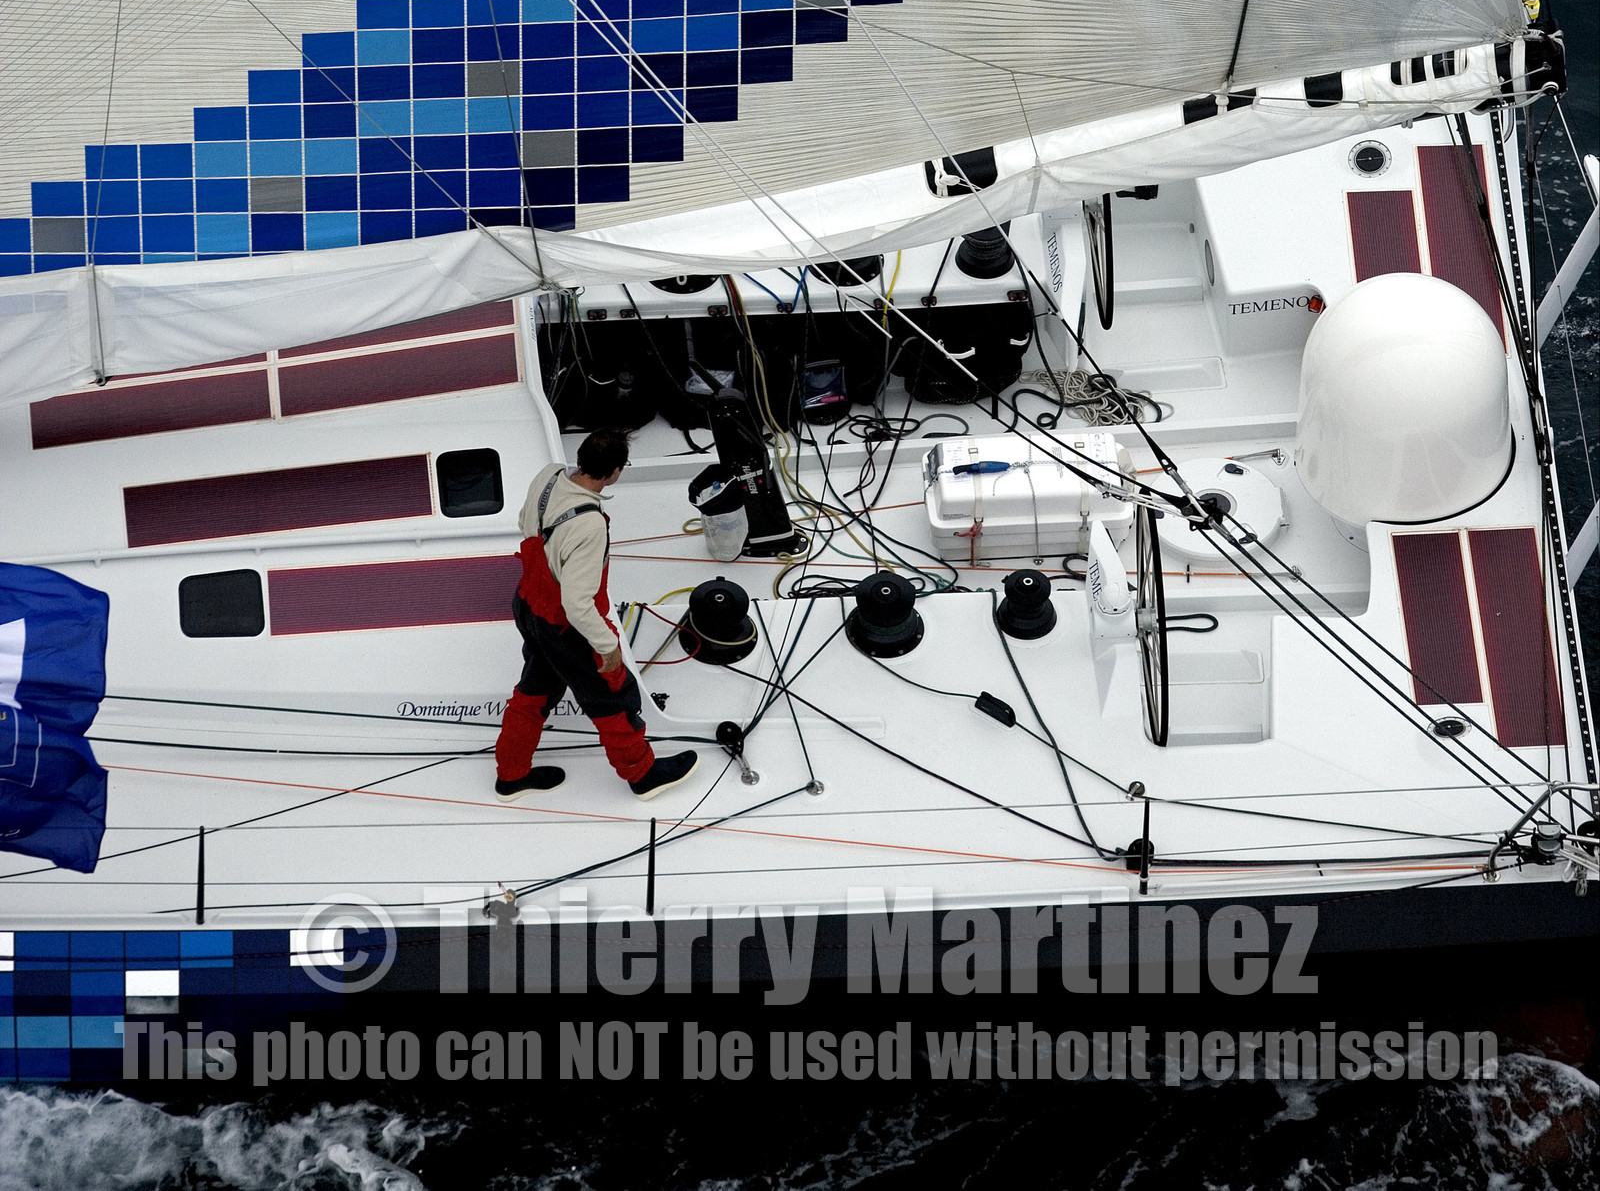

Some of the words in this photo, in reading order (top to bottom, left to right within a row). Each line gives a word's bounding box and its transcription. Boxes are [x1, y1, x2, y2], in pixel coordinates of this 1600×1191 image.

[1046, 231, 1063, 293] TEMENOS
[1228, 295, 1311, 315] TEMENO
[1089, 559, 1103, 602] TEME
[396, 699, 482, 722] Dominique
